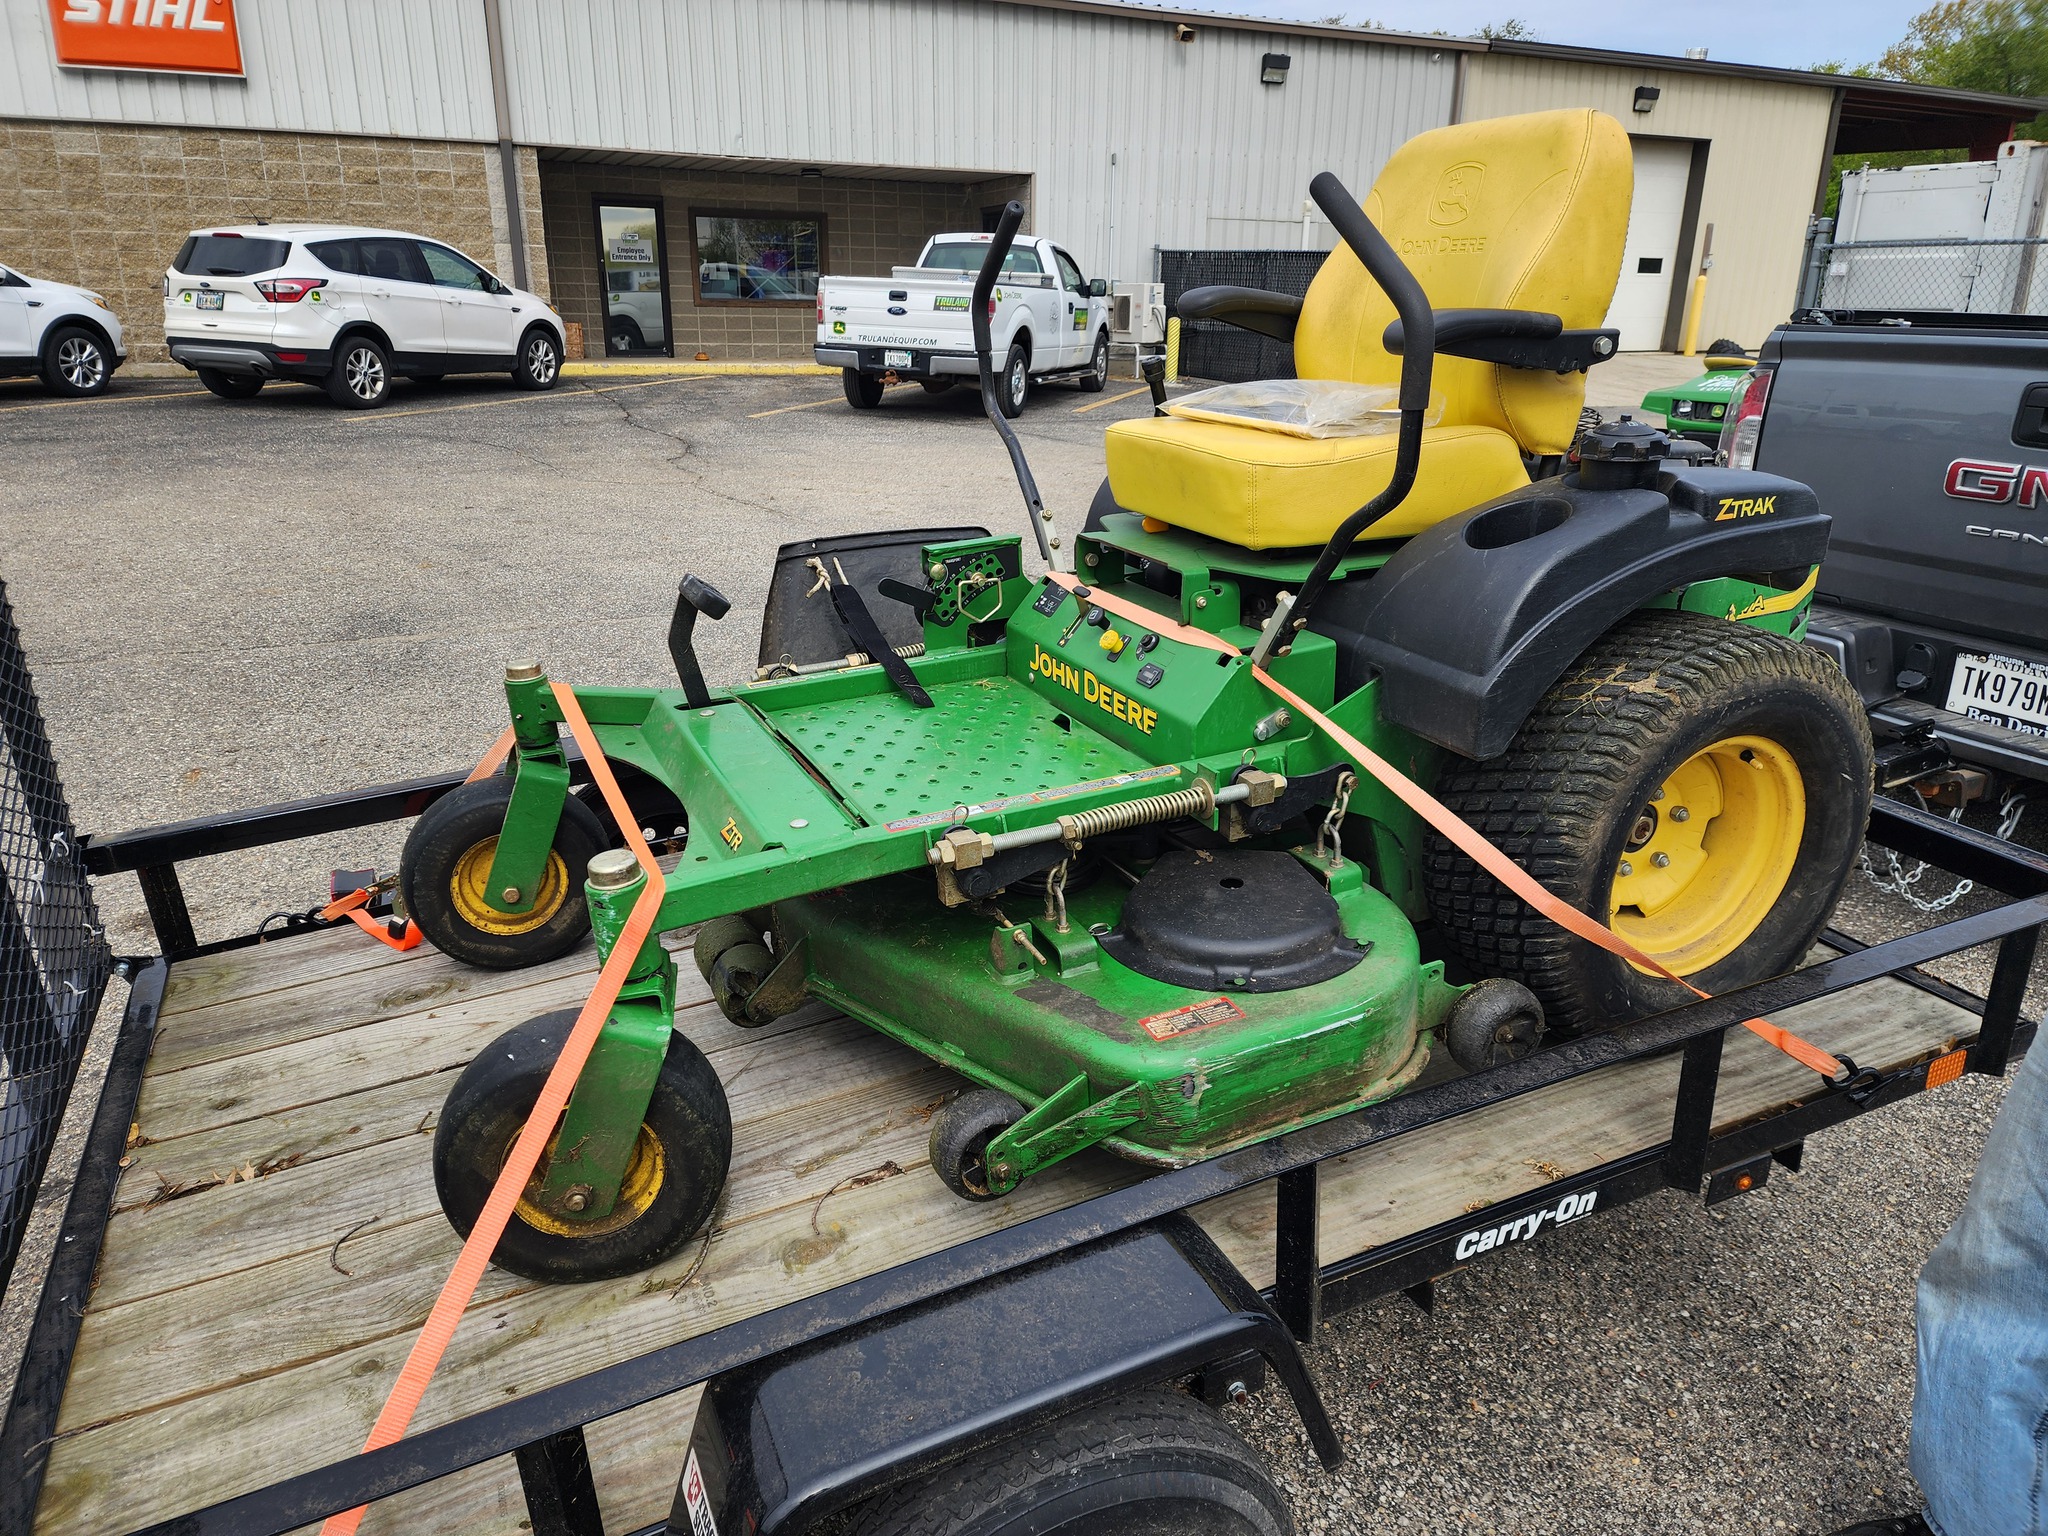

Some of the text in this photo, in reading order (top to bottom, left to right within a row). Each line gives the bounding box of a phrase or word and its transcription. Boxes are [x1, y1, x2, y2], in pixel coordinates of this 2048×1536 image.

[63, 0, 225, 31] STIHL
[617, 246, 645, 254] Employee
[1439, 236, 1487, 254] DEERE
[638, 253, 651, 262] Only
[936, 296, 970, 307] TRULAND
[858, 334, 938, 346] TRULANDEQUIP.COM
[1714, 495, 1777, 521] ZTRAK
[1988, 653, 2026, 667] AUBURN,
[1029, 642, 1158, 736] JOHN DEERE
[1967, 706, 2002, 727] Ben
[719, 816, 743, 853] ZTR
[1156, 1009, 1181, 1020] DANGER
[1455, 1190, 1598, 1262] Carry-On
